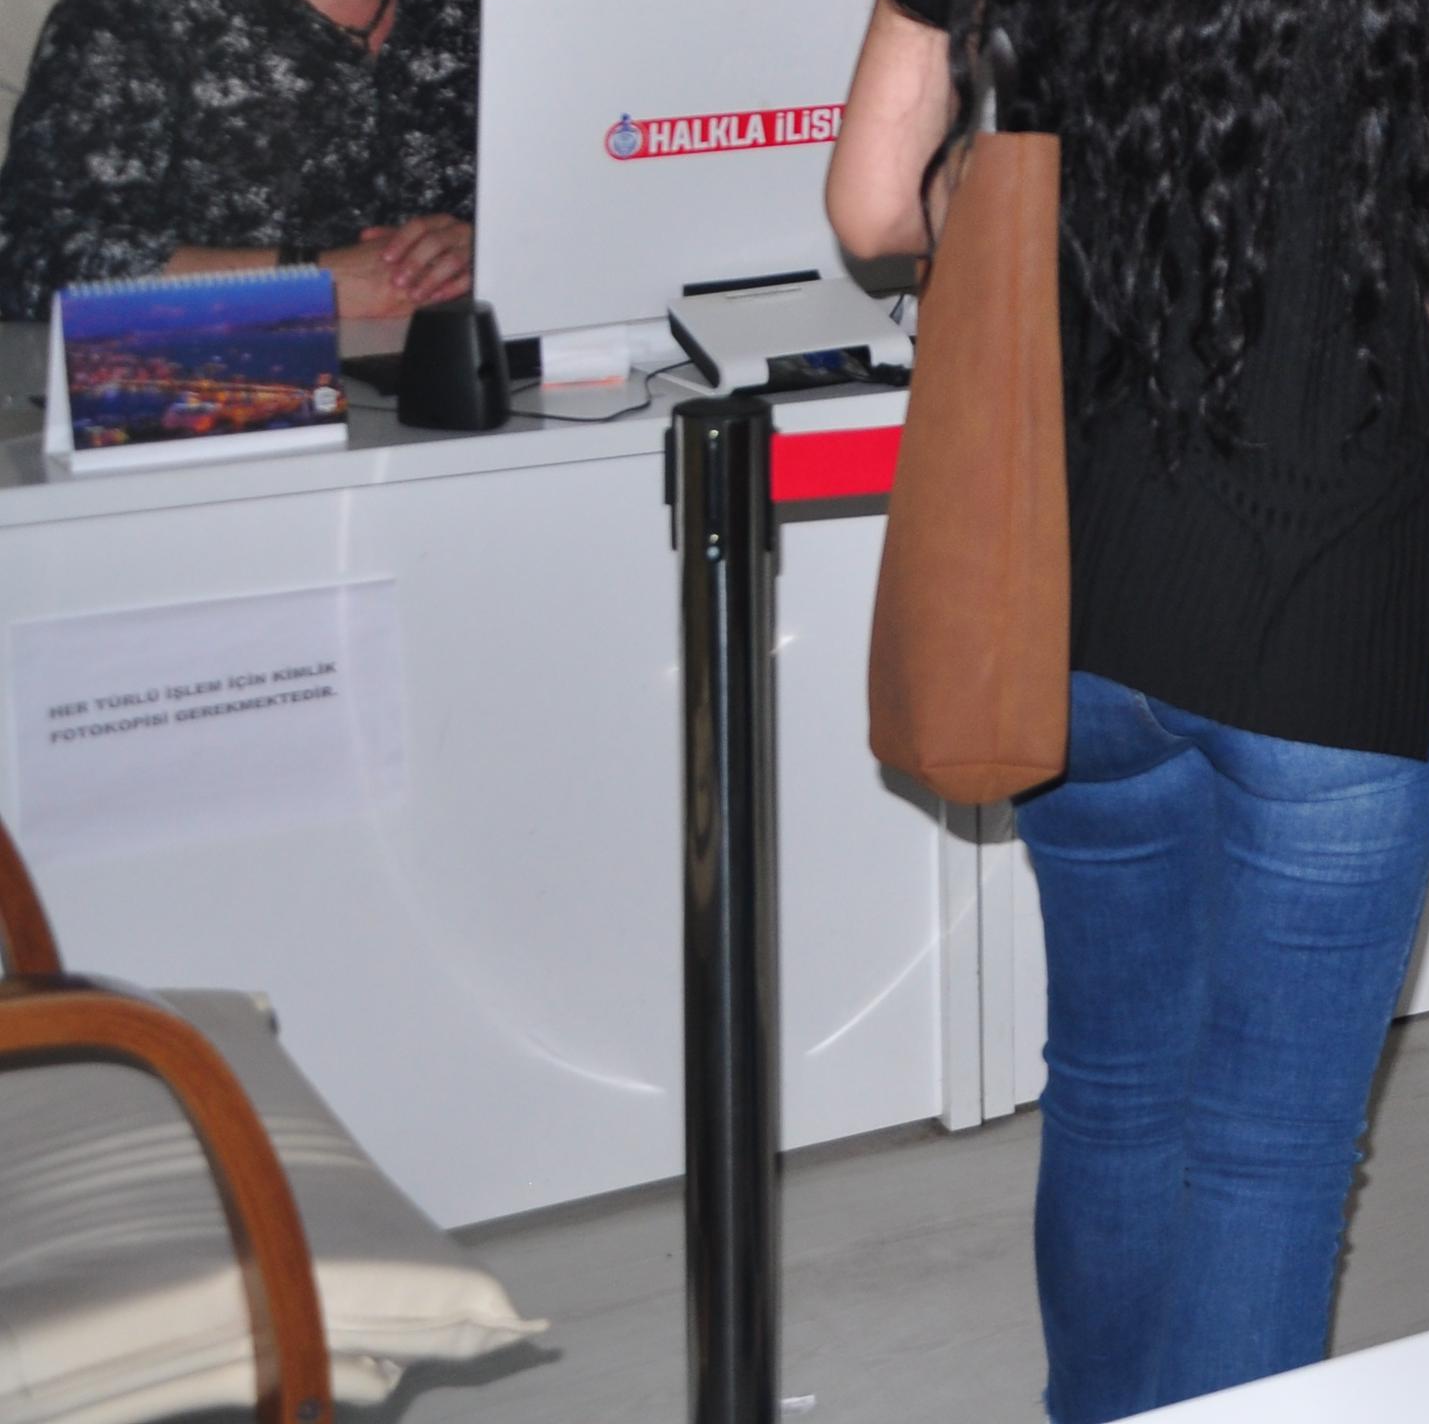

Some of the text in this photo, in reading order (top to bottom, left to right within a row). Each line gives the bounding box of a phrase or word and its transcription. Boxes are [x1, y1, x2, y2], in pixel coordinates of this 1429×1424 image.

[648, 112, 767, 155] HALKLA
[48, 661, 338, 720] HER TÜRLÜ İŞLEM İÇİN KİMLİK
[49, 685, 339, 745] FOTOKOPİSİ GEREKMEKTEDİR.
